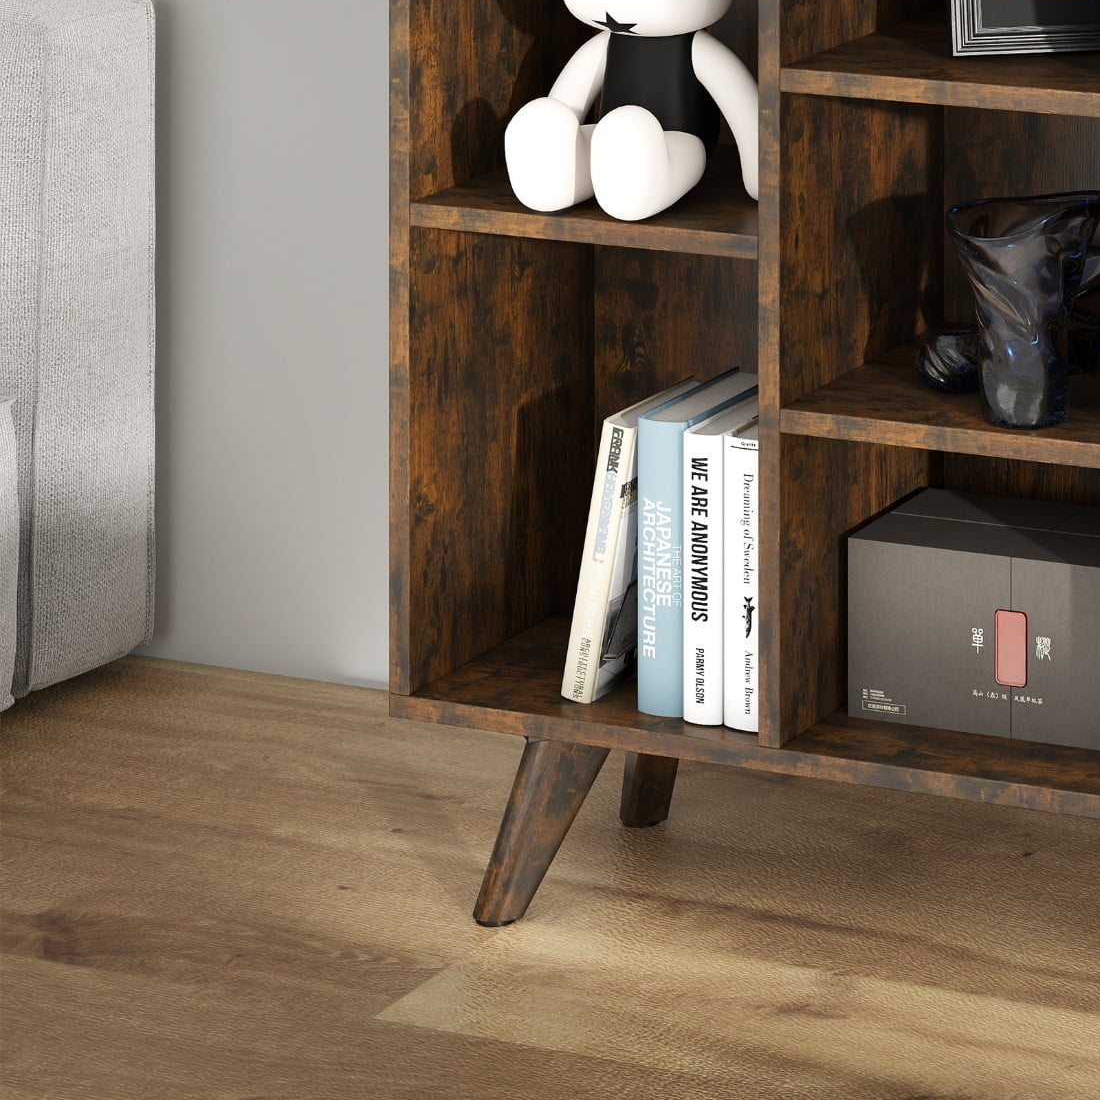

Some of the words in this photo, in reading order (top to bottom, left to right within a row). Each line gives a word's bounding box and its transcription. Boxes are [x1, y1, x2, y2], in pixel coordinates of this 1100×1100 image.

[691, 457, 708, 482] WE
[691, 485, 708, 517] ARE
[740, 473, 754, 526] Dreaming
[743, 529, 754, 540] of
[656, 500, 672, 608] JAPANESE
[672, 544, 682, 566] THE
[743, 542, 754, 585] Sweden
[643, 496, 656, 659] ARCHITECTURE
[672, 568, 682, 590] ART
[691, 521, 708, 623] ANONYMOUS
[672, 591, 682, 607] OF
[695, 647, 705, 675] PARMY
[743, 650, 754, 684] Andrew
[695, 677, 705, 704] OLSON
[743, 687, 754, 715] Brown
